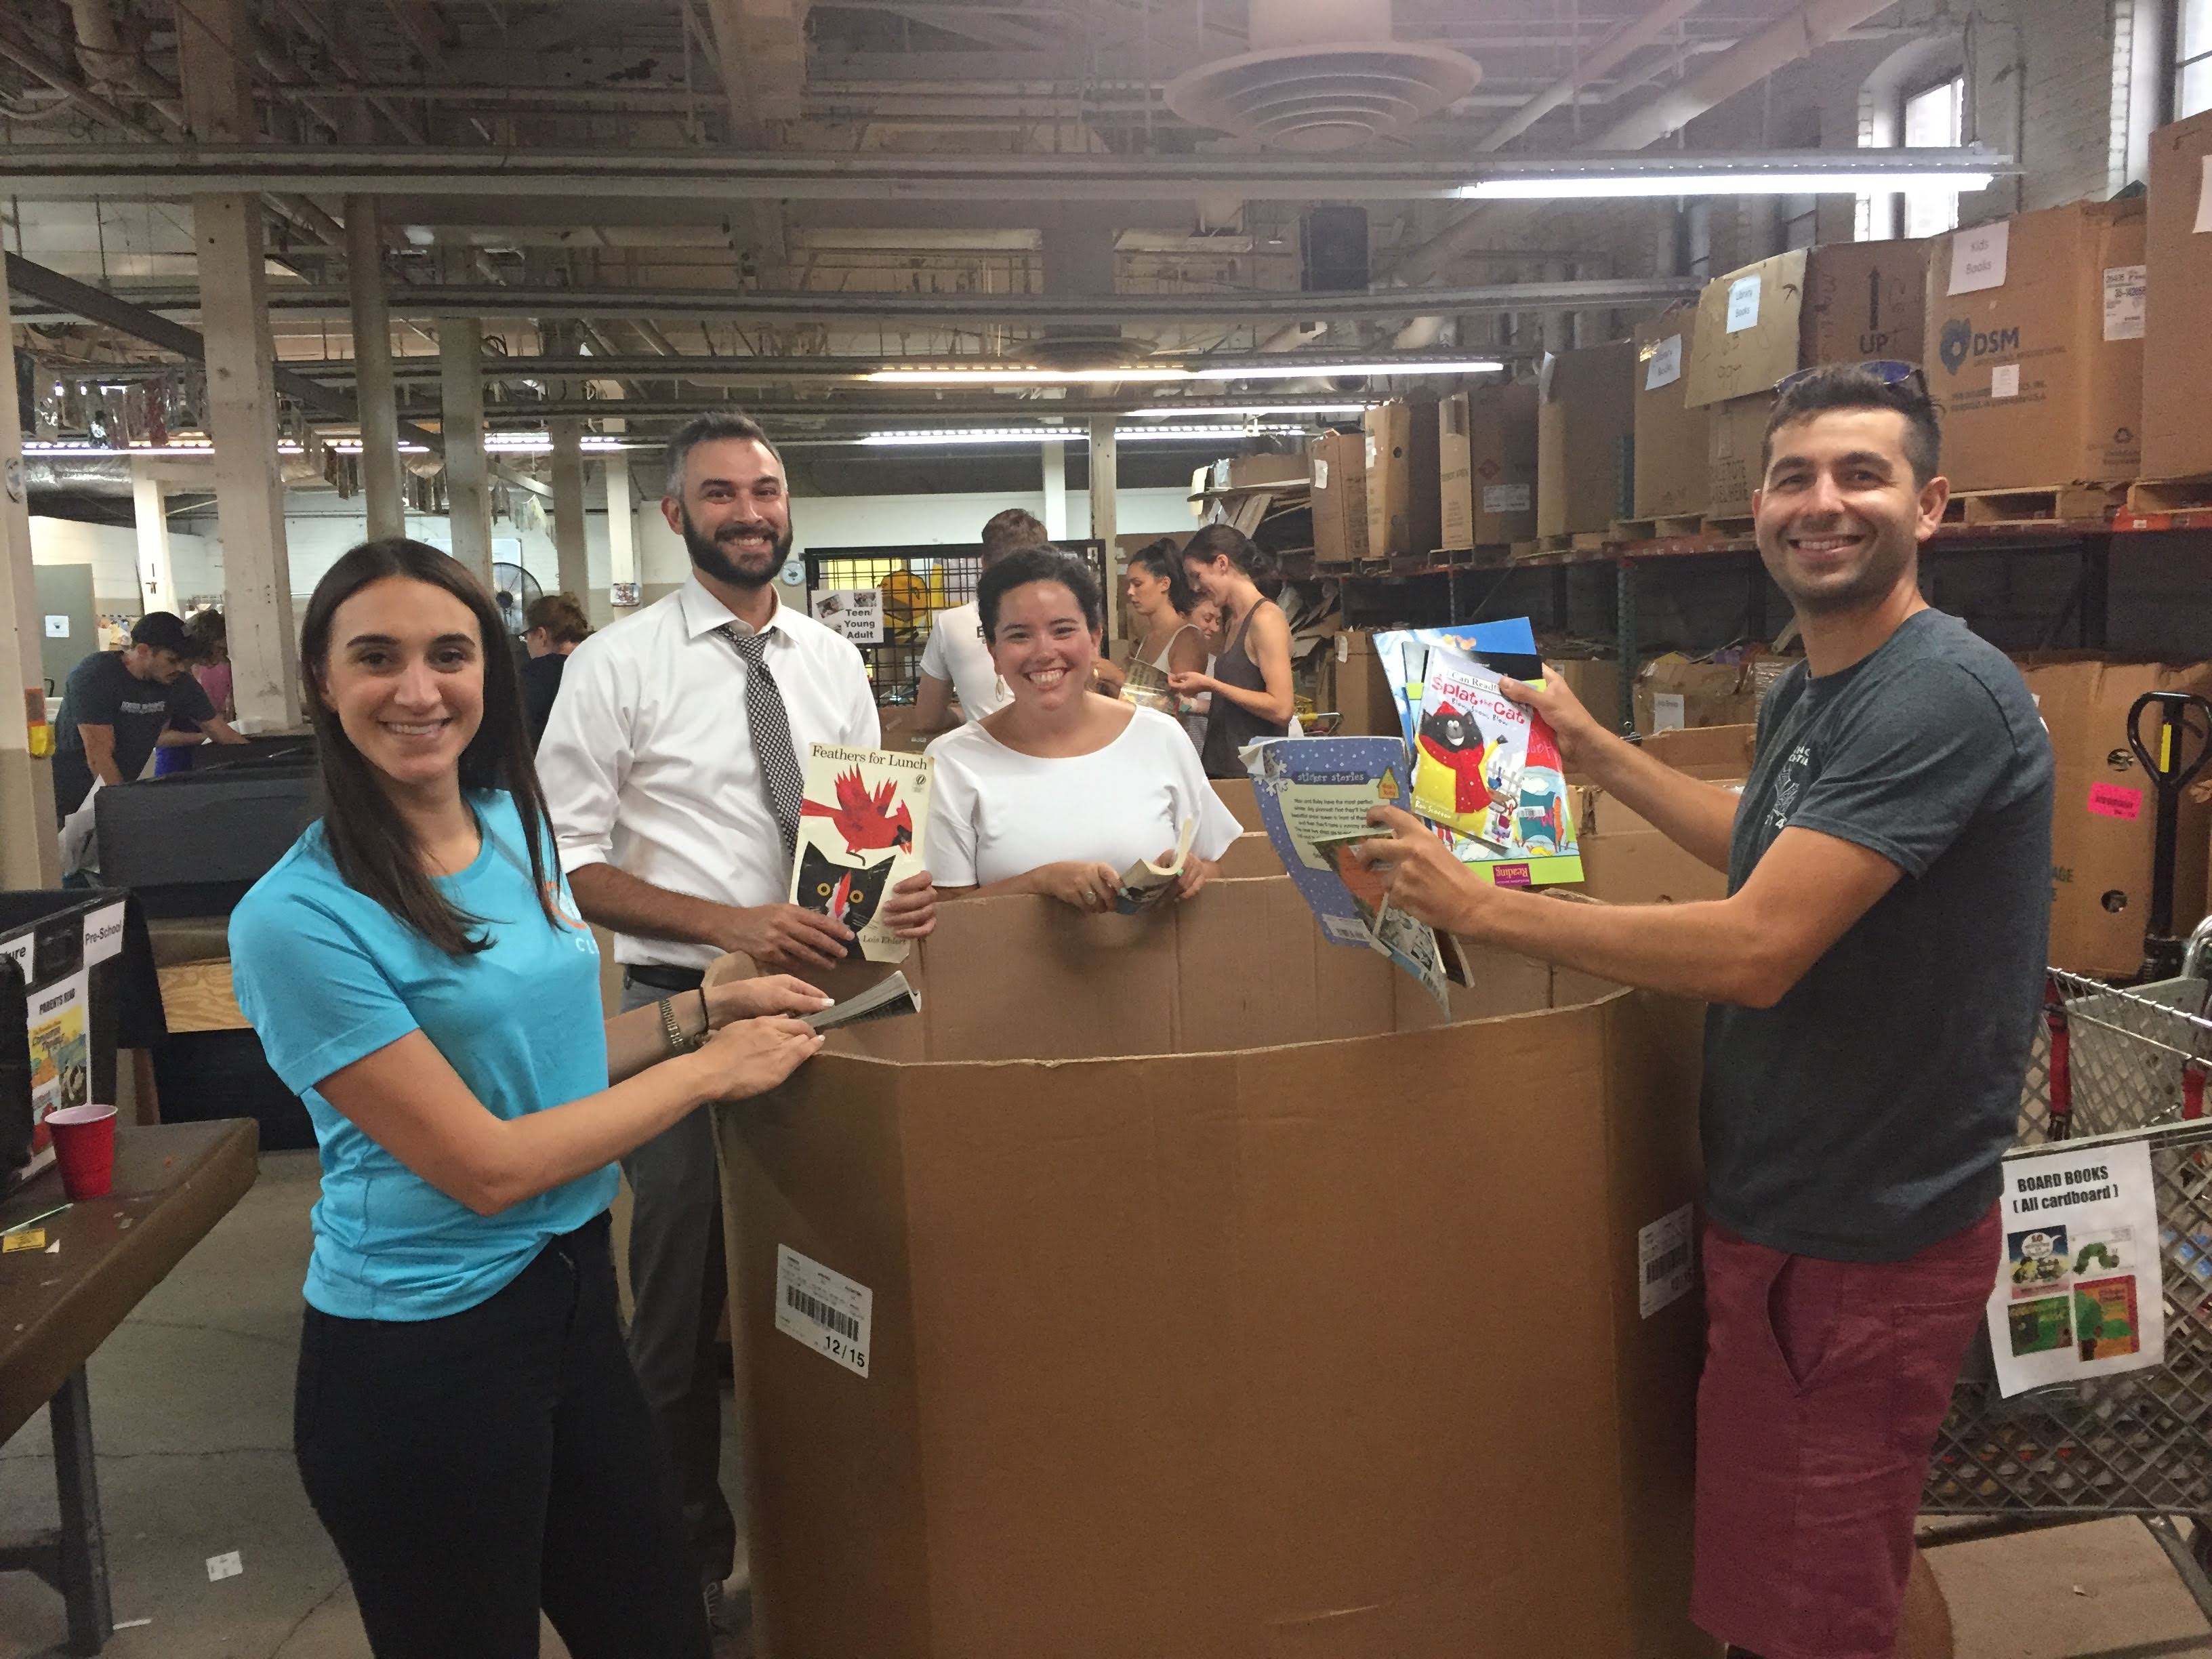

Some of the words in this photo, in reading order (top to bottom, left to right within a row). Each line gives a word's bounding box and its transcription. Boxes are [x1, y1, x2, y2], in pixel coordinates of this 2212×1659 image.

[1966, 260, 1992, 274] Books
[1860, 333, 1889, 354] UP
[1973, 326, 2020, 356] DSM
[844, 620, 875, 629] Young
[1452, 671, 1469, 684] Can
[1472, 678, 1496, 691] Read!
[1431, 674, 1478, 705] Splat
[1494, 701, 1525, 724] Cat
[813, 745, 866, 762] Feathers
[868, 752, 886, 765] for
[888, 754, 927, 770] Lunch
[1298, 773, 1328, 783] sticker
[1331, 772, 1364, 781] stories
[1495, 866, 1528, 879] Reading
[85, 920, 122, 946] Pre-School
[863, 935, 880, 944] Lois
[39, 995, 63, 1015] PARENTS
[2017, 1173, 2062, 1193] BOARD
[2064, 1165, 2109, 1185] BOOKS
[2022, 1197, 2039, 1212] All
[2041, 1185, 2111, 1209] cardboard
[825, 1336, 865, 1368] 12/15
